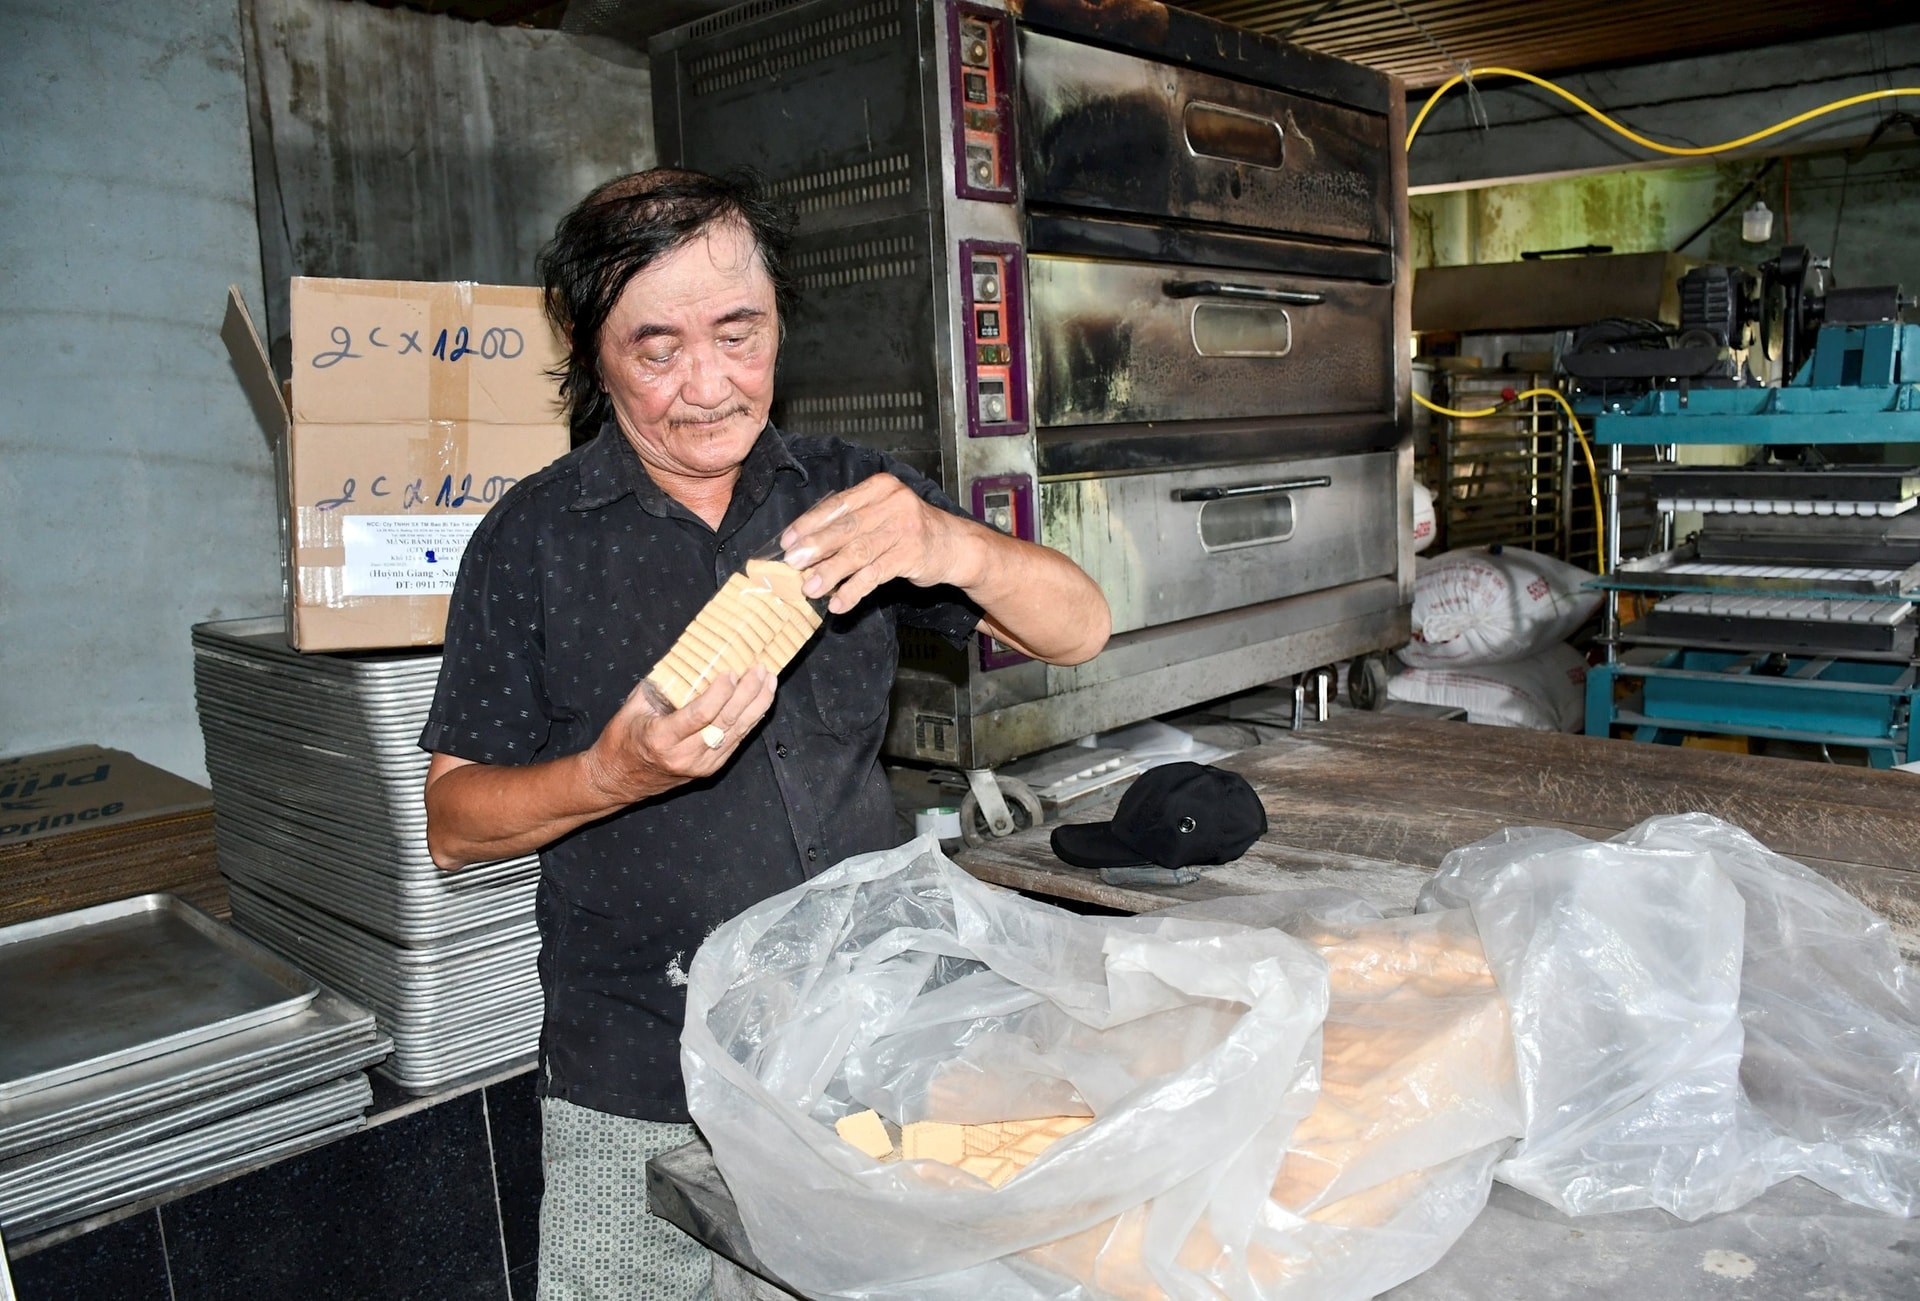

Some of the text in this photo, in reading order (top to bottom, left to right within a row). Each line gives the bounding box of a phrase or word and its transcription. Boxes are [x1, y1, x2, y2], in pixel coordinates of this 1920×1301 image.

[432, 326, 524, 362] 1200
[406, 569, 434, 579] Giang
[415, 581, 436, 589] 0911
